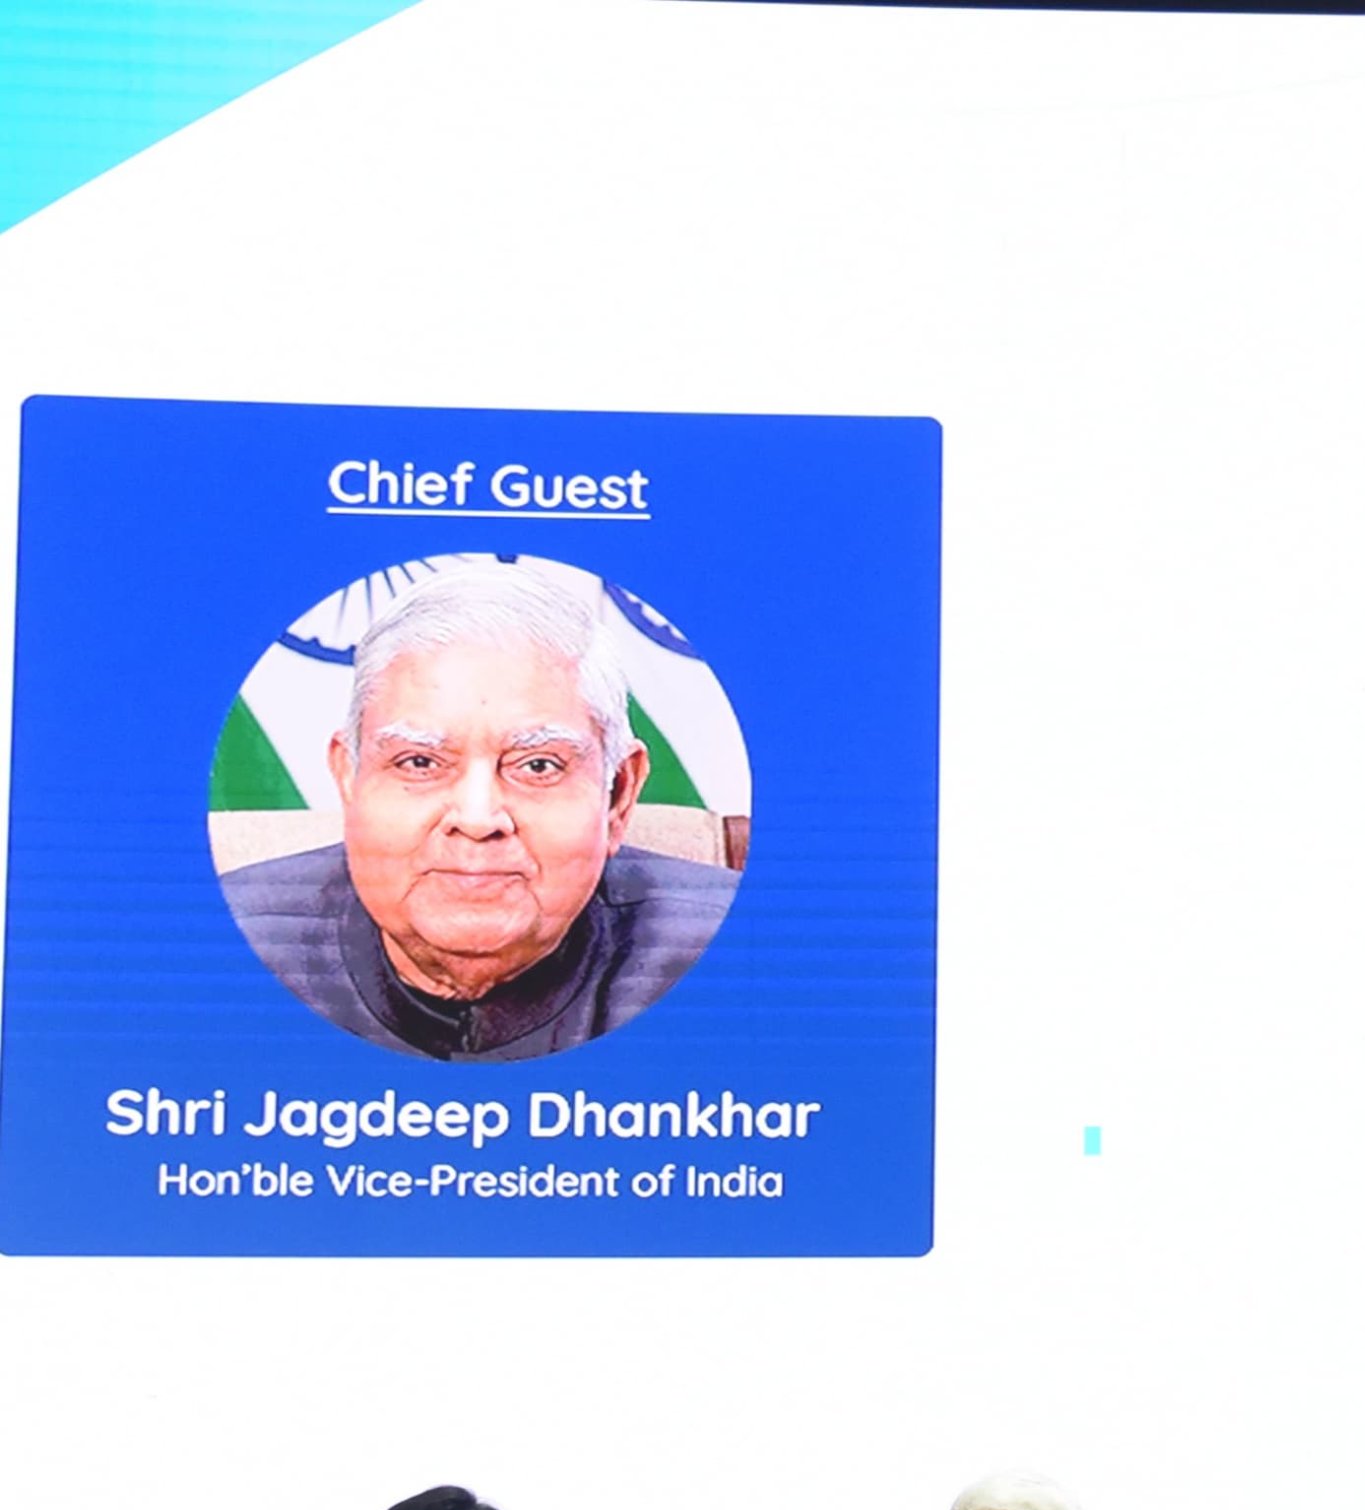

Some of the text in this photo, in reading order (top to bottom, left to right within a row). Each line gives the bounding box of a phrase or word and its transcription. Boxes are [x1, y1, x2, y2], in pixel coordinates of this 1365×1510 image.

[328, 460, 649, 510] Chief Guest
[106, 1087, 821, 1149] Shri Jagdeep Dhankhar
[325, 1163, 620, 1198] Vice-President
[631, 1163, 677, 1198] of
[686, 1164, 783, 1198] India
